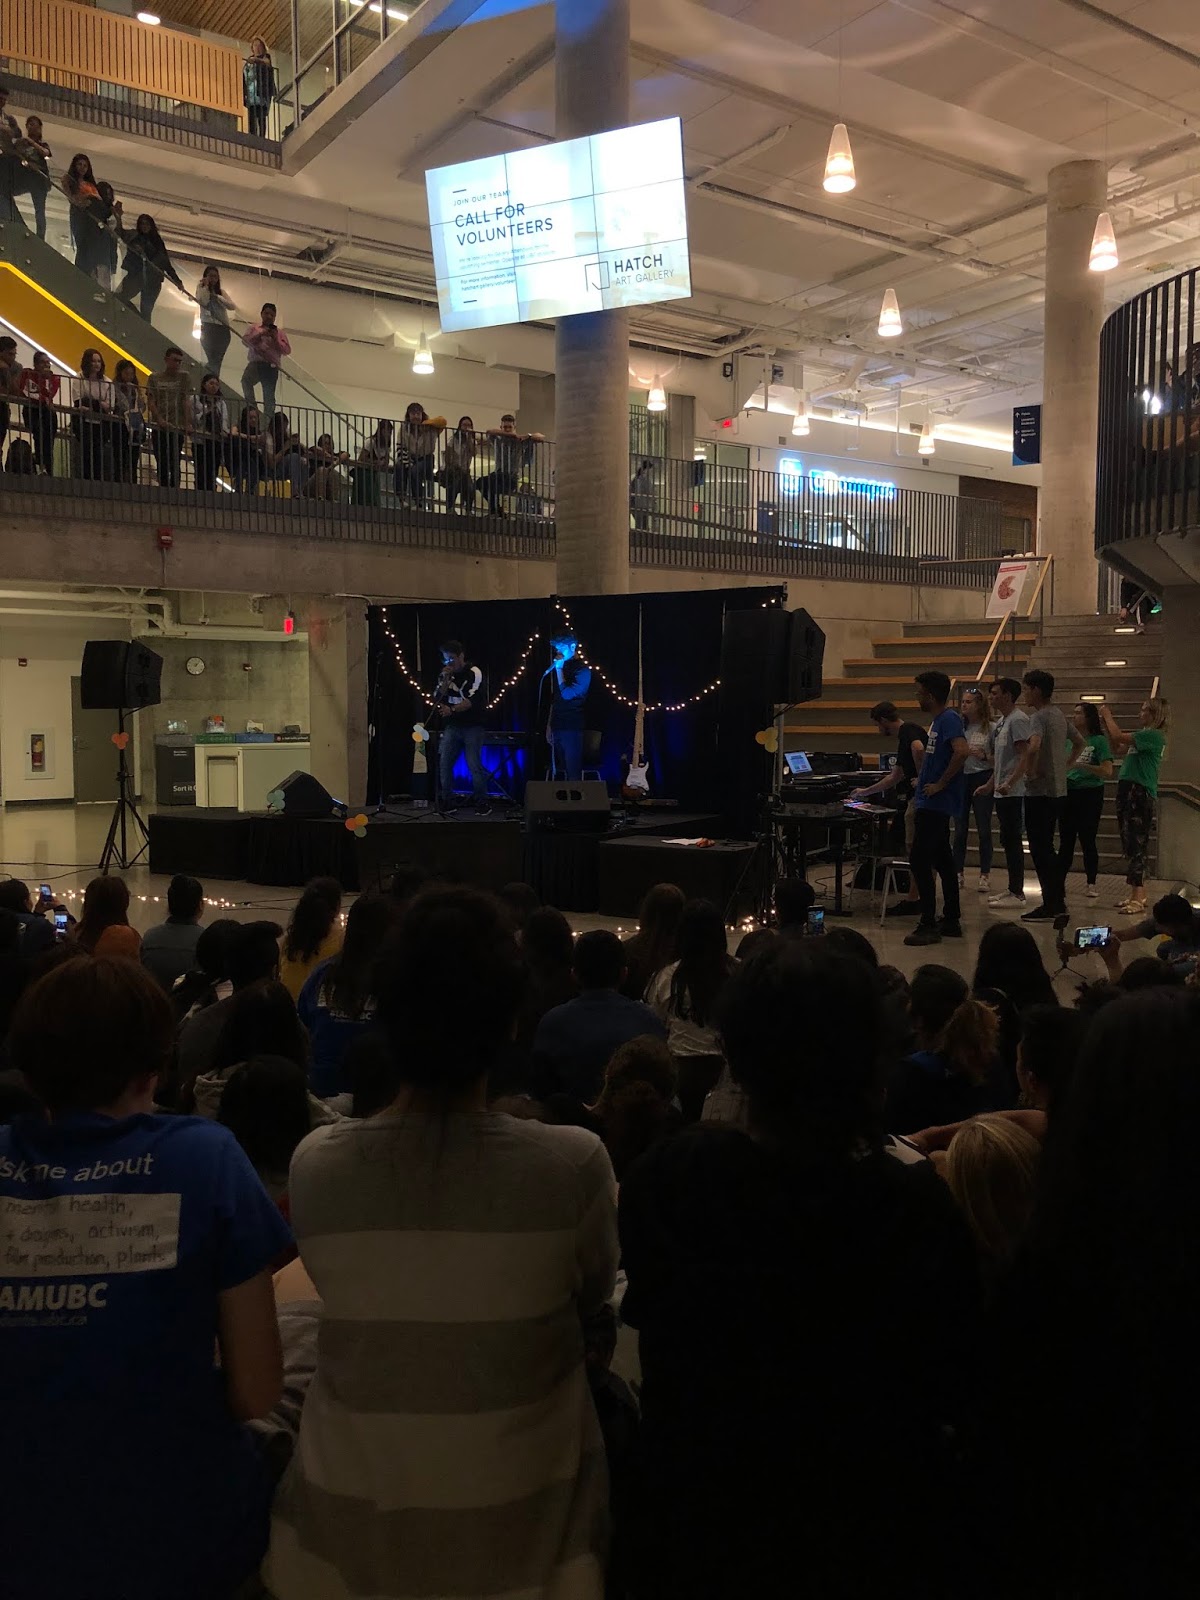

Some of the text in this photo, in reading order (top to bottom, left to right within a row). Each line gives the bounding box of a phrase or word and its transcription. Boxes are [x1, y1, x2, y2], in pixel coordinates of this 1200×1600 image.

[453, 196, 470, 207] JOIN
[471, 194, 487, 203] OUR
[455, 203, 525, 228] CALL FOR
[456, 217, 553, 246] VOLUNTEERS
[614, 253, 663, 273] HATCH
[615, 269, 675, 286] ART GALLERY
[73, 1152, 155, 1182] about
